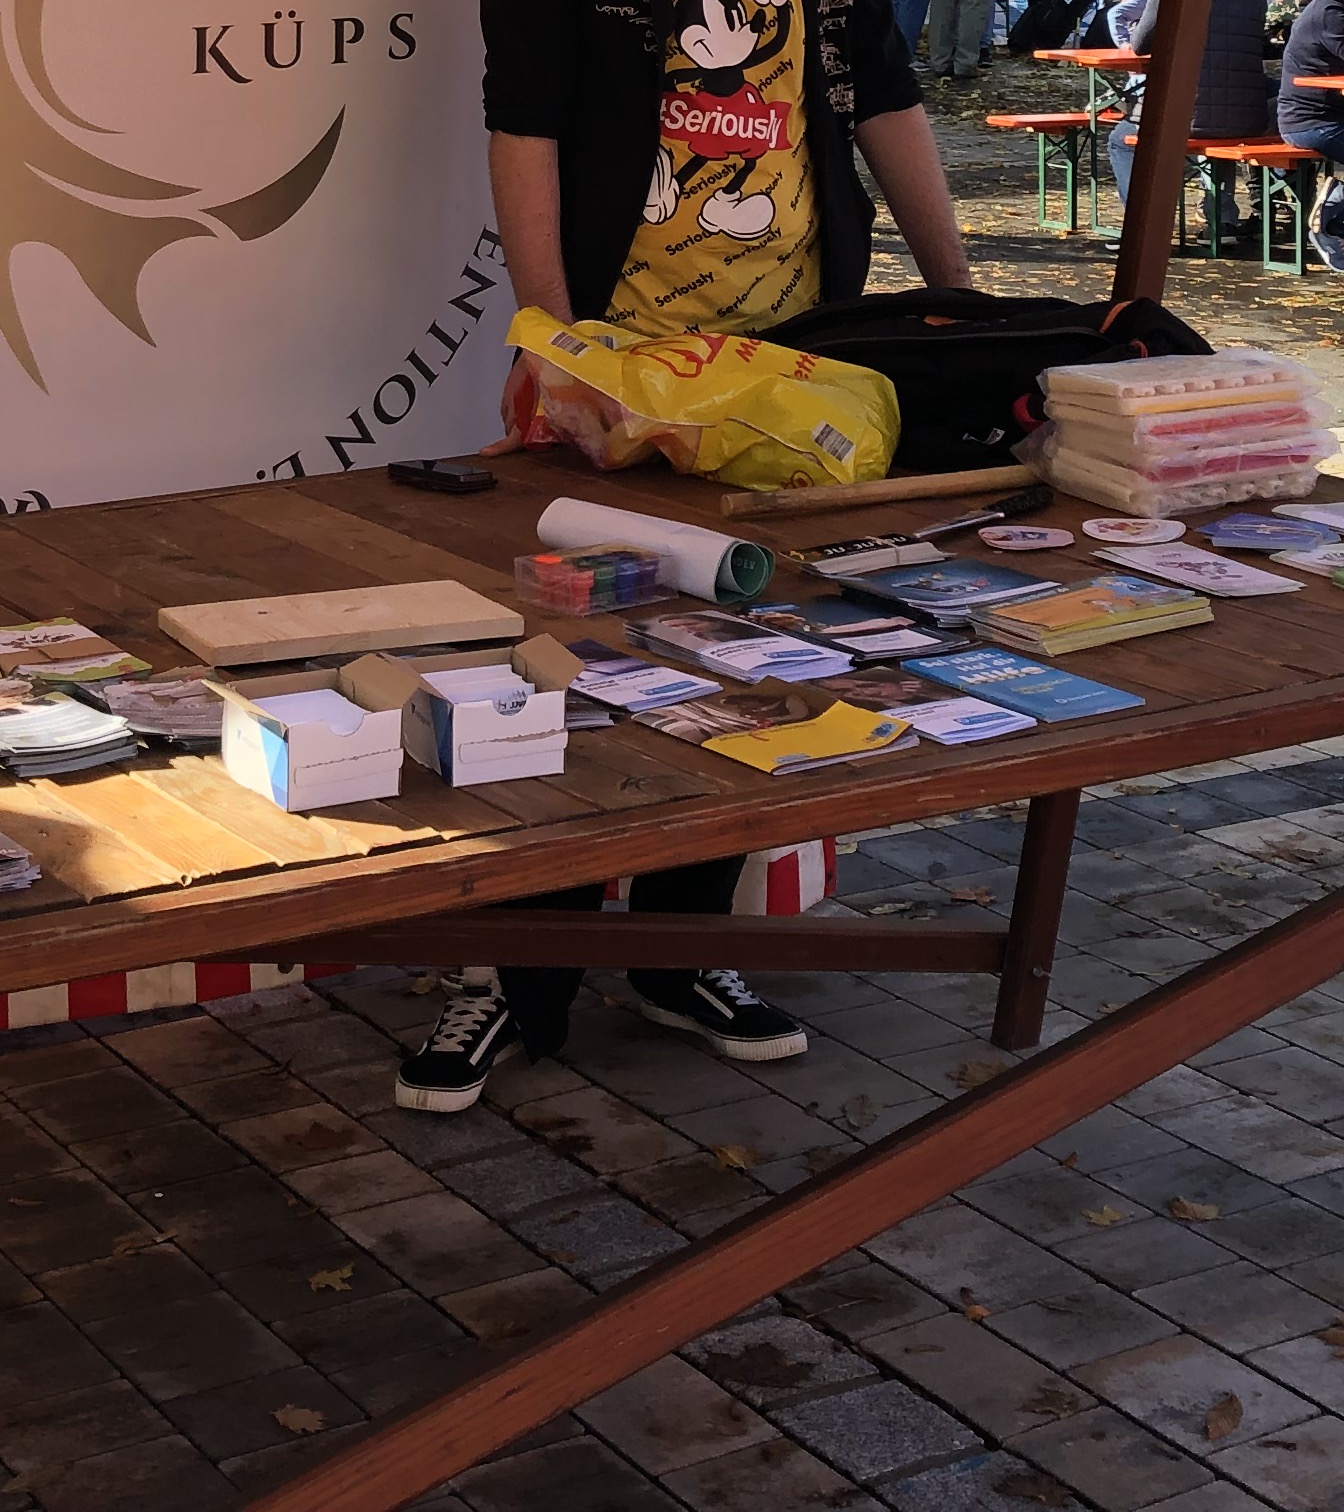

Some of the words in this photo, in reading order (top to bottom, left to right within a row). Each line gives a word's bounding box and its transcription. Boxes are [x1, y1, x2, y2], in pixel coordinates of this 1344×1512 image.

[191, 9, 417, 85] KÜPS
[757, 58, 794, 93] riously
[682, 162, 738, 200] Seriously
[654, 271, 716, 308] Seriously
[324, 223, 507, 472] ENTION
